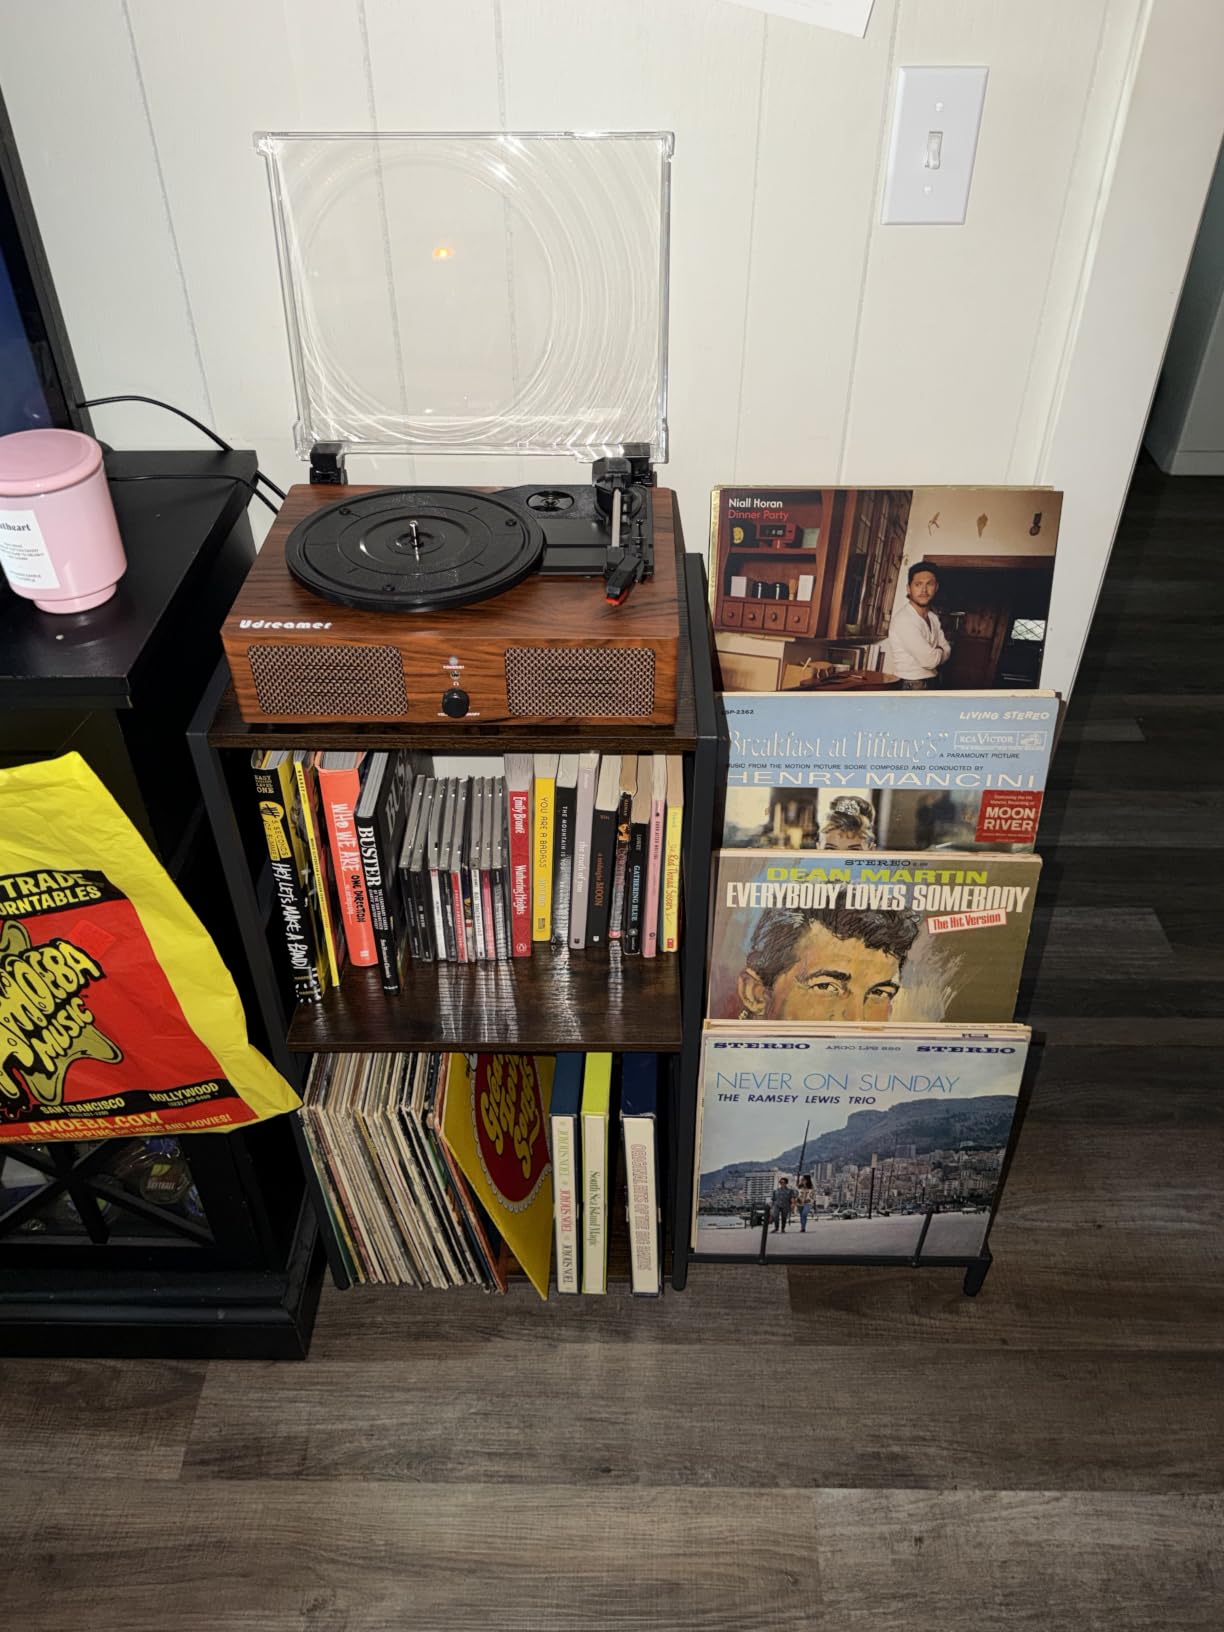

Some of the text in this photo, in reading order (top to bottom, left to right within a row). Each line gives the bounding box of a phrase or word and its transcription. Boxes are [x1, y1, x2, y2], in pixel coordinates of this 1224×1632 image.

[728, 498, 783, 508] Niall Horan
[728, 510, 789, 521] Dinner Party
[240, 620, 333, 629] Udreamer
[959, 711, 1050, 721] LIVING STEREO
[828, 737, 847, 757] at
[959, 735, 976, 744] RCA
[728, 771, 1035, 788] HENRY MANCINI
[512, 796, 527, 813] Emily
[539, 797, 548, 813] YOU
[985, 806, 1036, 820] MOON
[331, 802, 353, 828] WHO
[539, 816, 548, 829] ARE
[983, 819, 1034, 832] RIVER
[336, 829, 356, 848] WE
[340, 849, 361, 872] ARE
[357, 825, 382, 887] BUSTER
[538, 840, 547, 868] BADASS
[845, 859, 911, 867] STEREO
[574, 841, 587, 893] the truth of you
[767, 867, 989, 884] DEAN MARTIN
[0, 872, 93, 898] TRADE
[666, 867, 677, 888] Thread
[351, 874, 366, 923] ONE DIRECTION
[513, 864, 527, 915] Wuthering Heights
[631, 865, 641, 922] GATHERING BLUE
[726, 882, 1030, 913] EVERYBODY LOVES SOMEBODY
[281, 904, 302, 931] MAKE
[933, 913, 1002, 931] The Hit Version
[285, 932, 304, 941] A
[32, 997, 94, 1072] MUSIC
[714, 1042, 811, 1050] STEREO
[917, 1046, 1016, 1054] STEREO
[716, 1072, 960, 1093] NEVER ON SUNDAY
[148, 1082, 219, 1102] HOLLYWOOD
[718, 1093, 876, 1105] THE RAMSEY LEWIS TRIO
[40, 1097, 126, 1114] SAN FRANCISCO
[28, 1111, 164, 1133] AMOEBA.COM
[186, 1113, 232, 1129] MOVIES!
[631, 1144, 648, 1185] ORIGINAL
[559, 1189, 571, 1217] JOYOUS
[634, 1186, 649, 1203] HITS
[588, 1170, 601, 1247] South Sea Island Magic
[635, 1205, 649, 1214] OF
[635, 1216, 650, 1231] THE
[562, 1243, 573, 1266] JOYOUS
